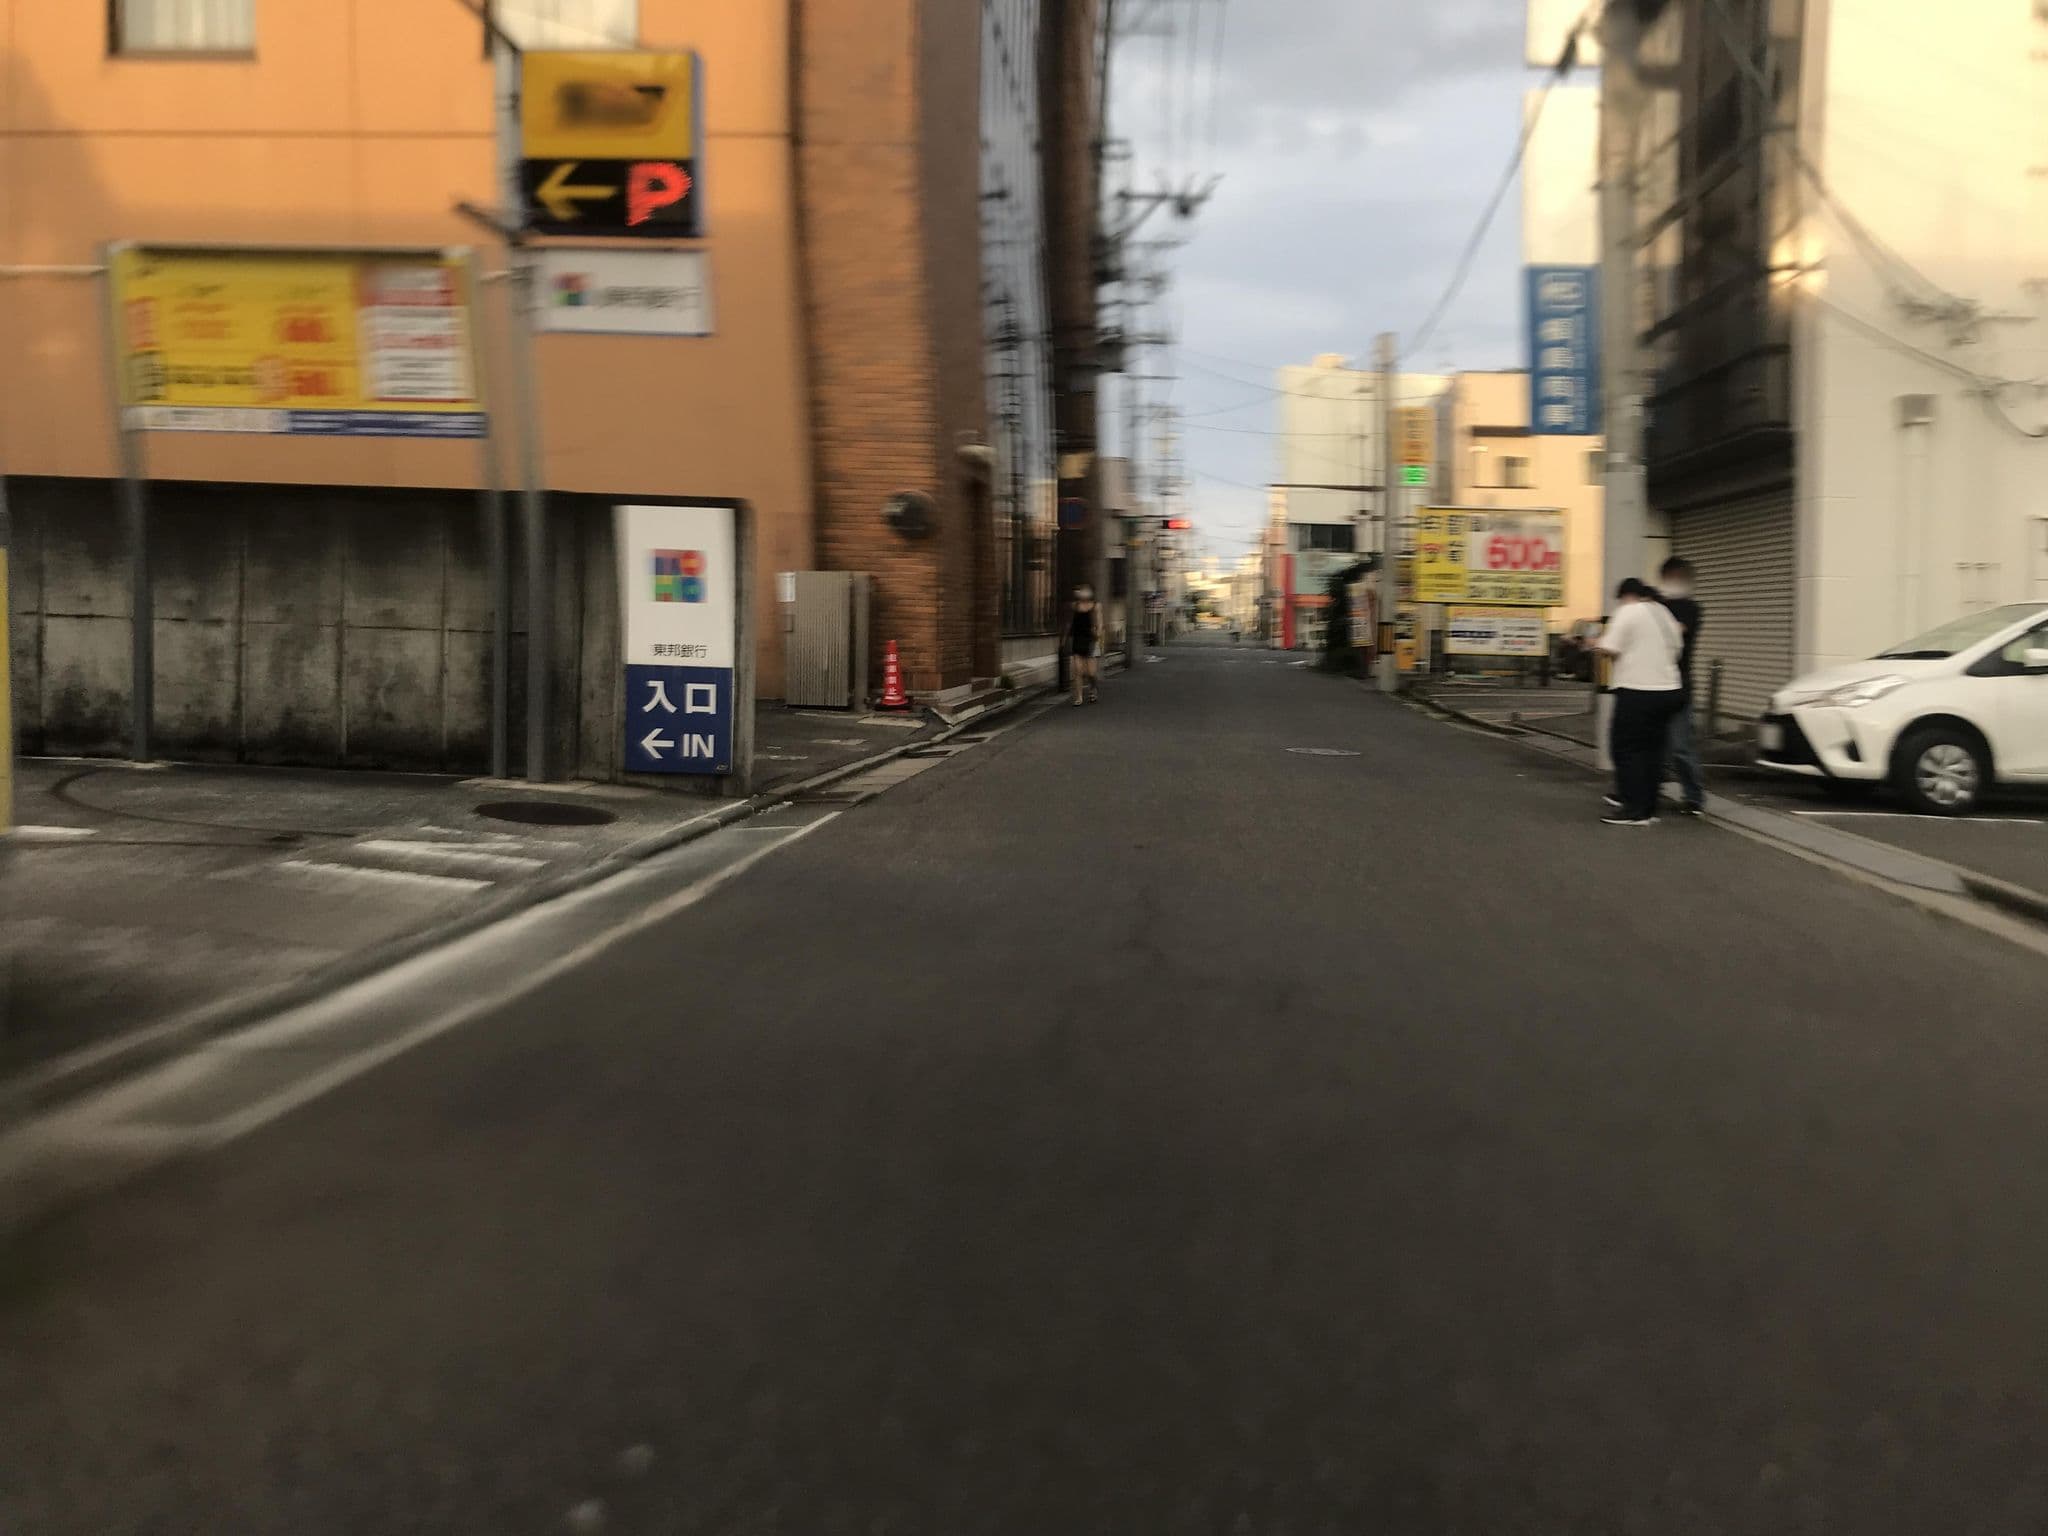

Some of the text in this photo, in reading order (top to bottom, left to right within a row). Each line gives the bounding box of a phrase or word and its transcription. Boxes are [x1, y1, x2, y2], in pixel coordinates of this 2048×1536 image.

[626, 161, 692, 226] P
[653, 643, 708, 658] 東邦銀行
[642, 680, 717, 715] 入口
[682, 733, 715, 758] IN
